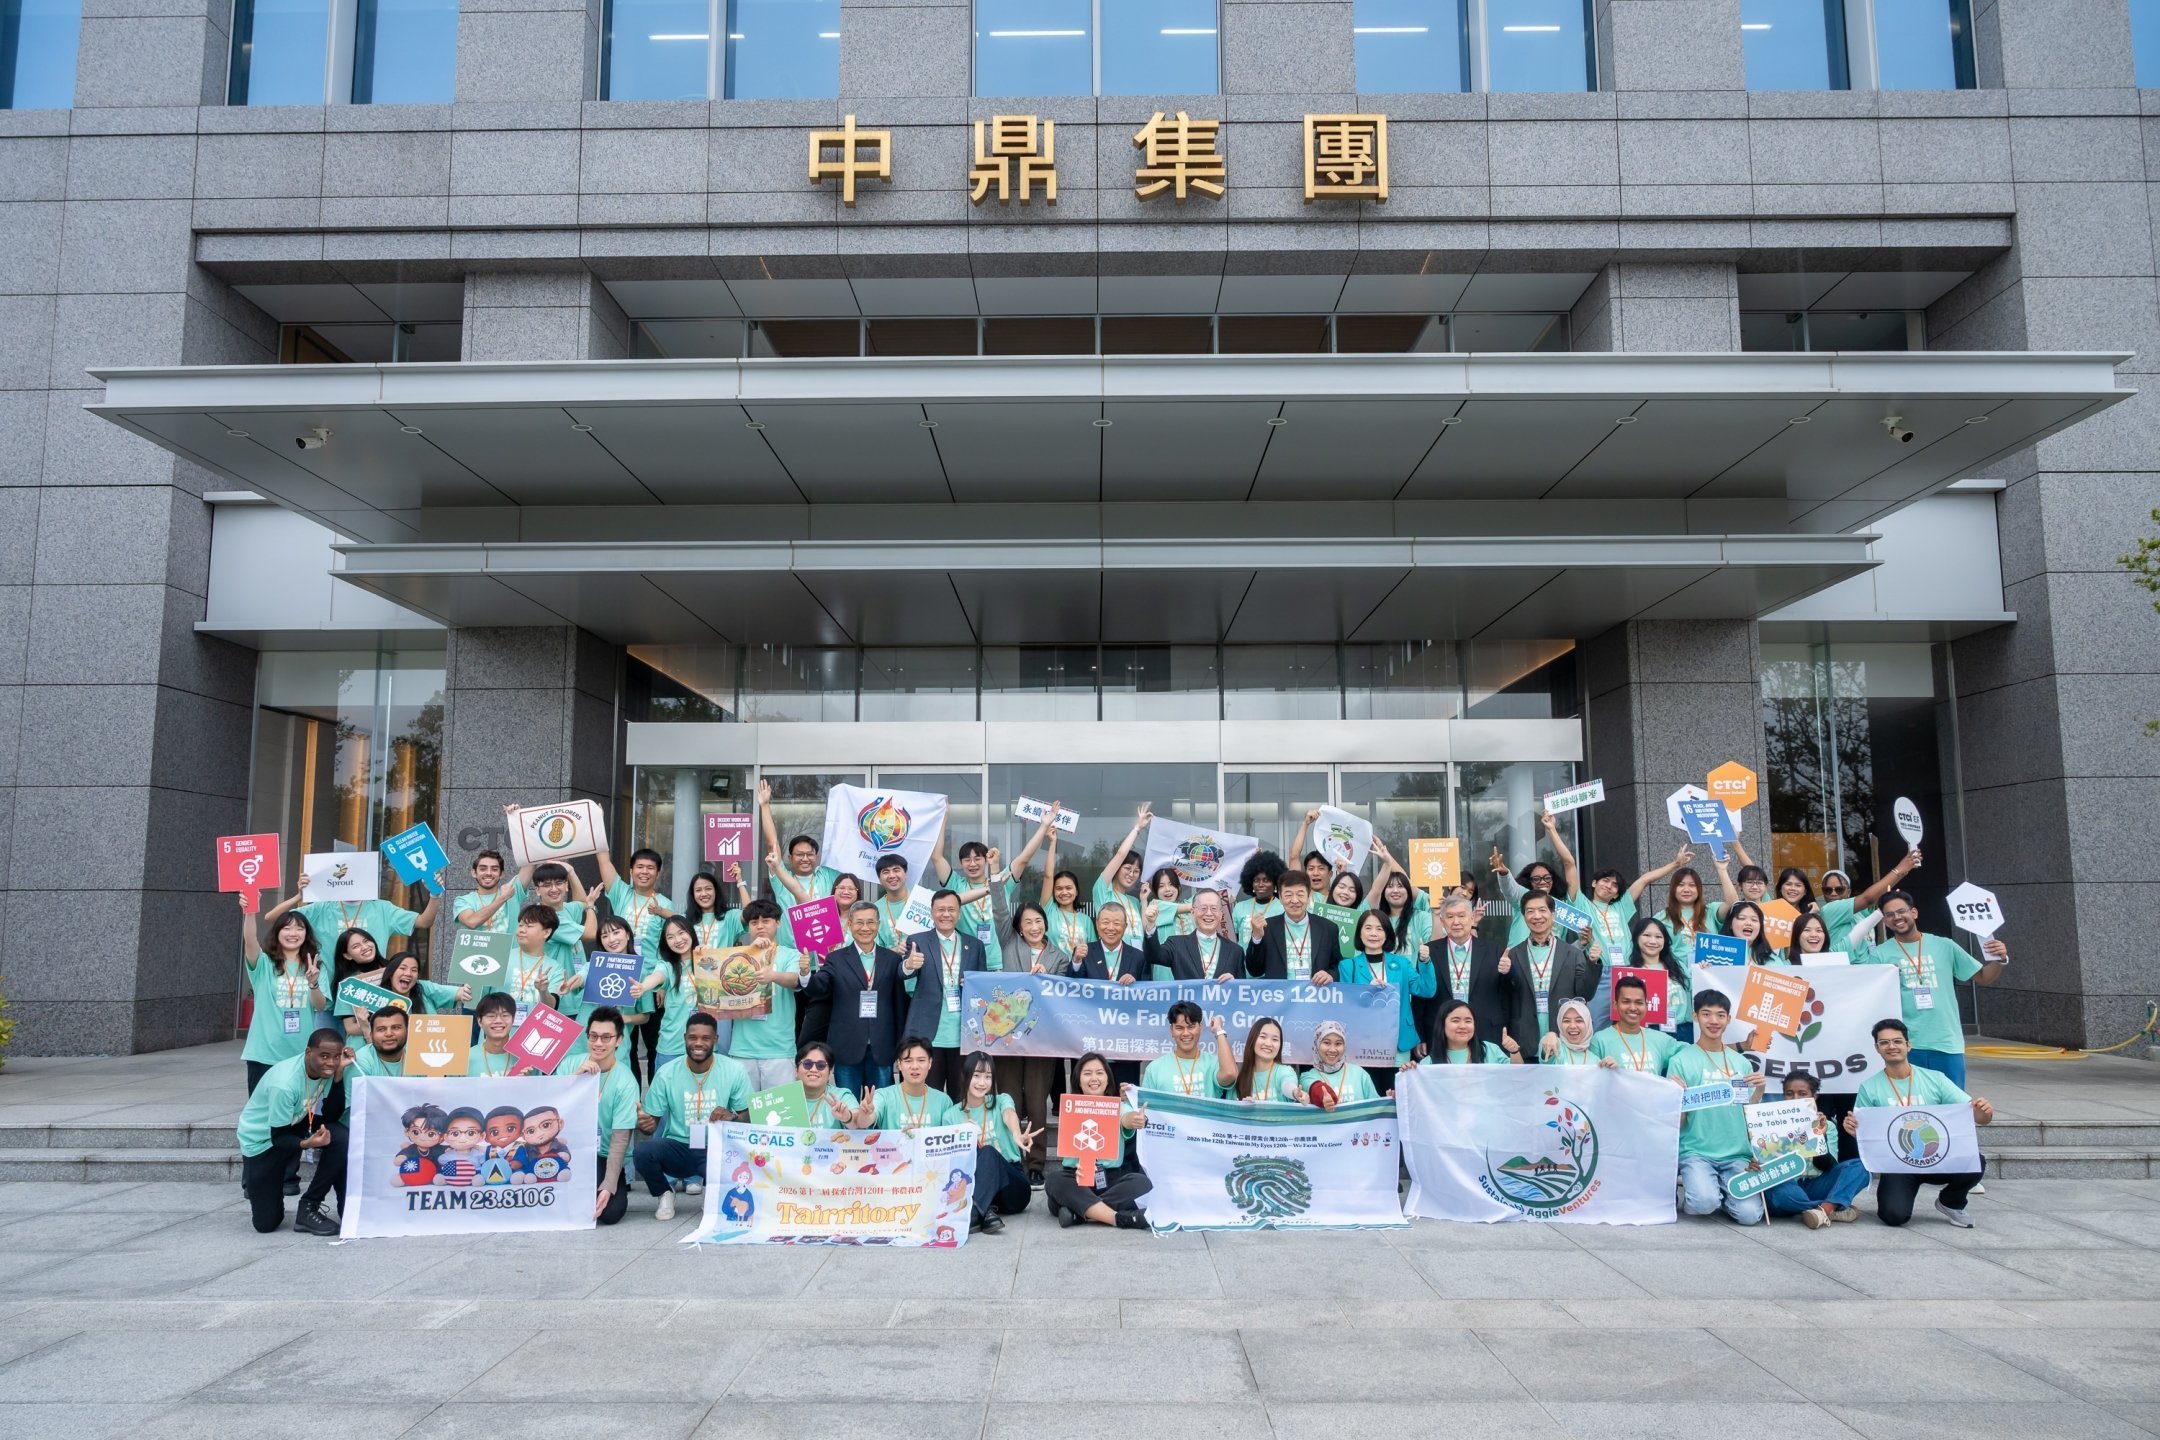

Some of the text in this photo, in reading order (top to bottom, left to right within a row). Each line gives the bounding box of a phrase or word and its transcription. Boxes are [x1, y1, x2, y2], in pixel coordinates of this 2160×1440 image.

[808, 111, 1389, 209] 中鼎集團
[1713, 781, 1746, 790] CTCI
[1682, 804, 1693, 814] 16
[530, 809, 582, 828] PEANUT EXPLORERS
[710, 818, 715, 828] 8
[1898, 812, 1912, 822] CTCI
[223, 842, 231, 854] 5
[387, 844, 396, 854] 6
[1414, 843, 1419, 855] 7
[327, 879, 354, 889] Sprout
[1318, 907, 1323, 917] 3
[1956, 902, 1990, 914] CTCI
[792, 910, 803, 921] 10
[460, 934, 471, 946] 13
[1700, 938, 1709, 949] 14
[595, 956, 605, 968] 17
[1752, 971, 1762, 984] 11
[1041, 980, 1343, 1006] 2026 Taiwan in My Eyes 120h
[534, 1009, 545, 1020] 4
[1098, 1009, 1130, 1026] We
[1137, 1010, 1171, 1027] Far
[415, 1019, 423, 1033] 2
[752, 1097, 762, 1110] 15
[1065, 1100, 1072, 1113] 9
[1756, 1107, 1801, 1118] Four Lands
[1747, 1116, 1811, 1129] One Table Team
[748, 1133, 794, 1147] GOALS
[925, 1132, 973, 1146] CTCI EF
[1902, 1153, 1942, 1166] HARMONY
[779, 1187, 798, 1195] 2026
[406, 1186, 555, 1211] TEAM 23.8106
[776, 1200, 921, 1225] Tairritory
